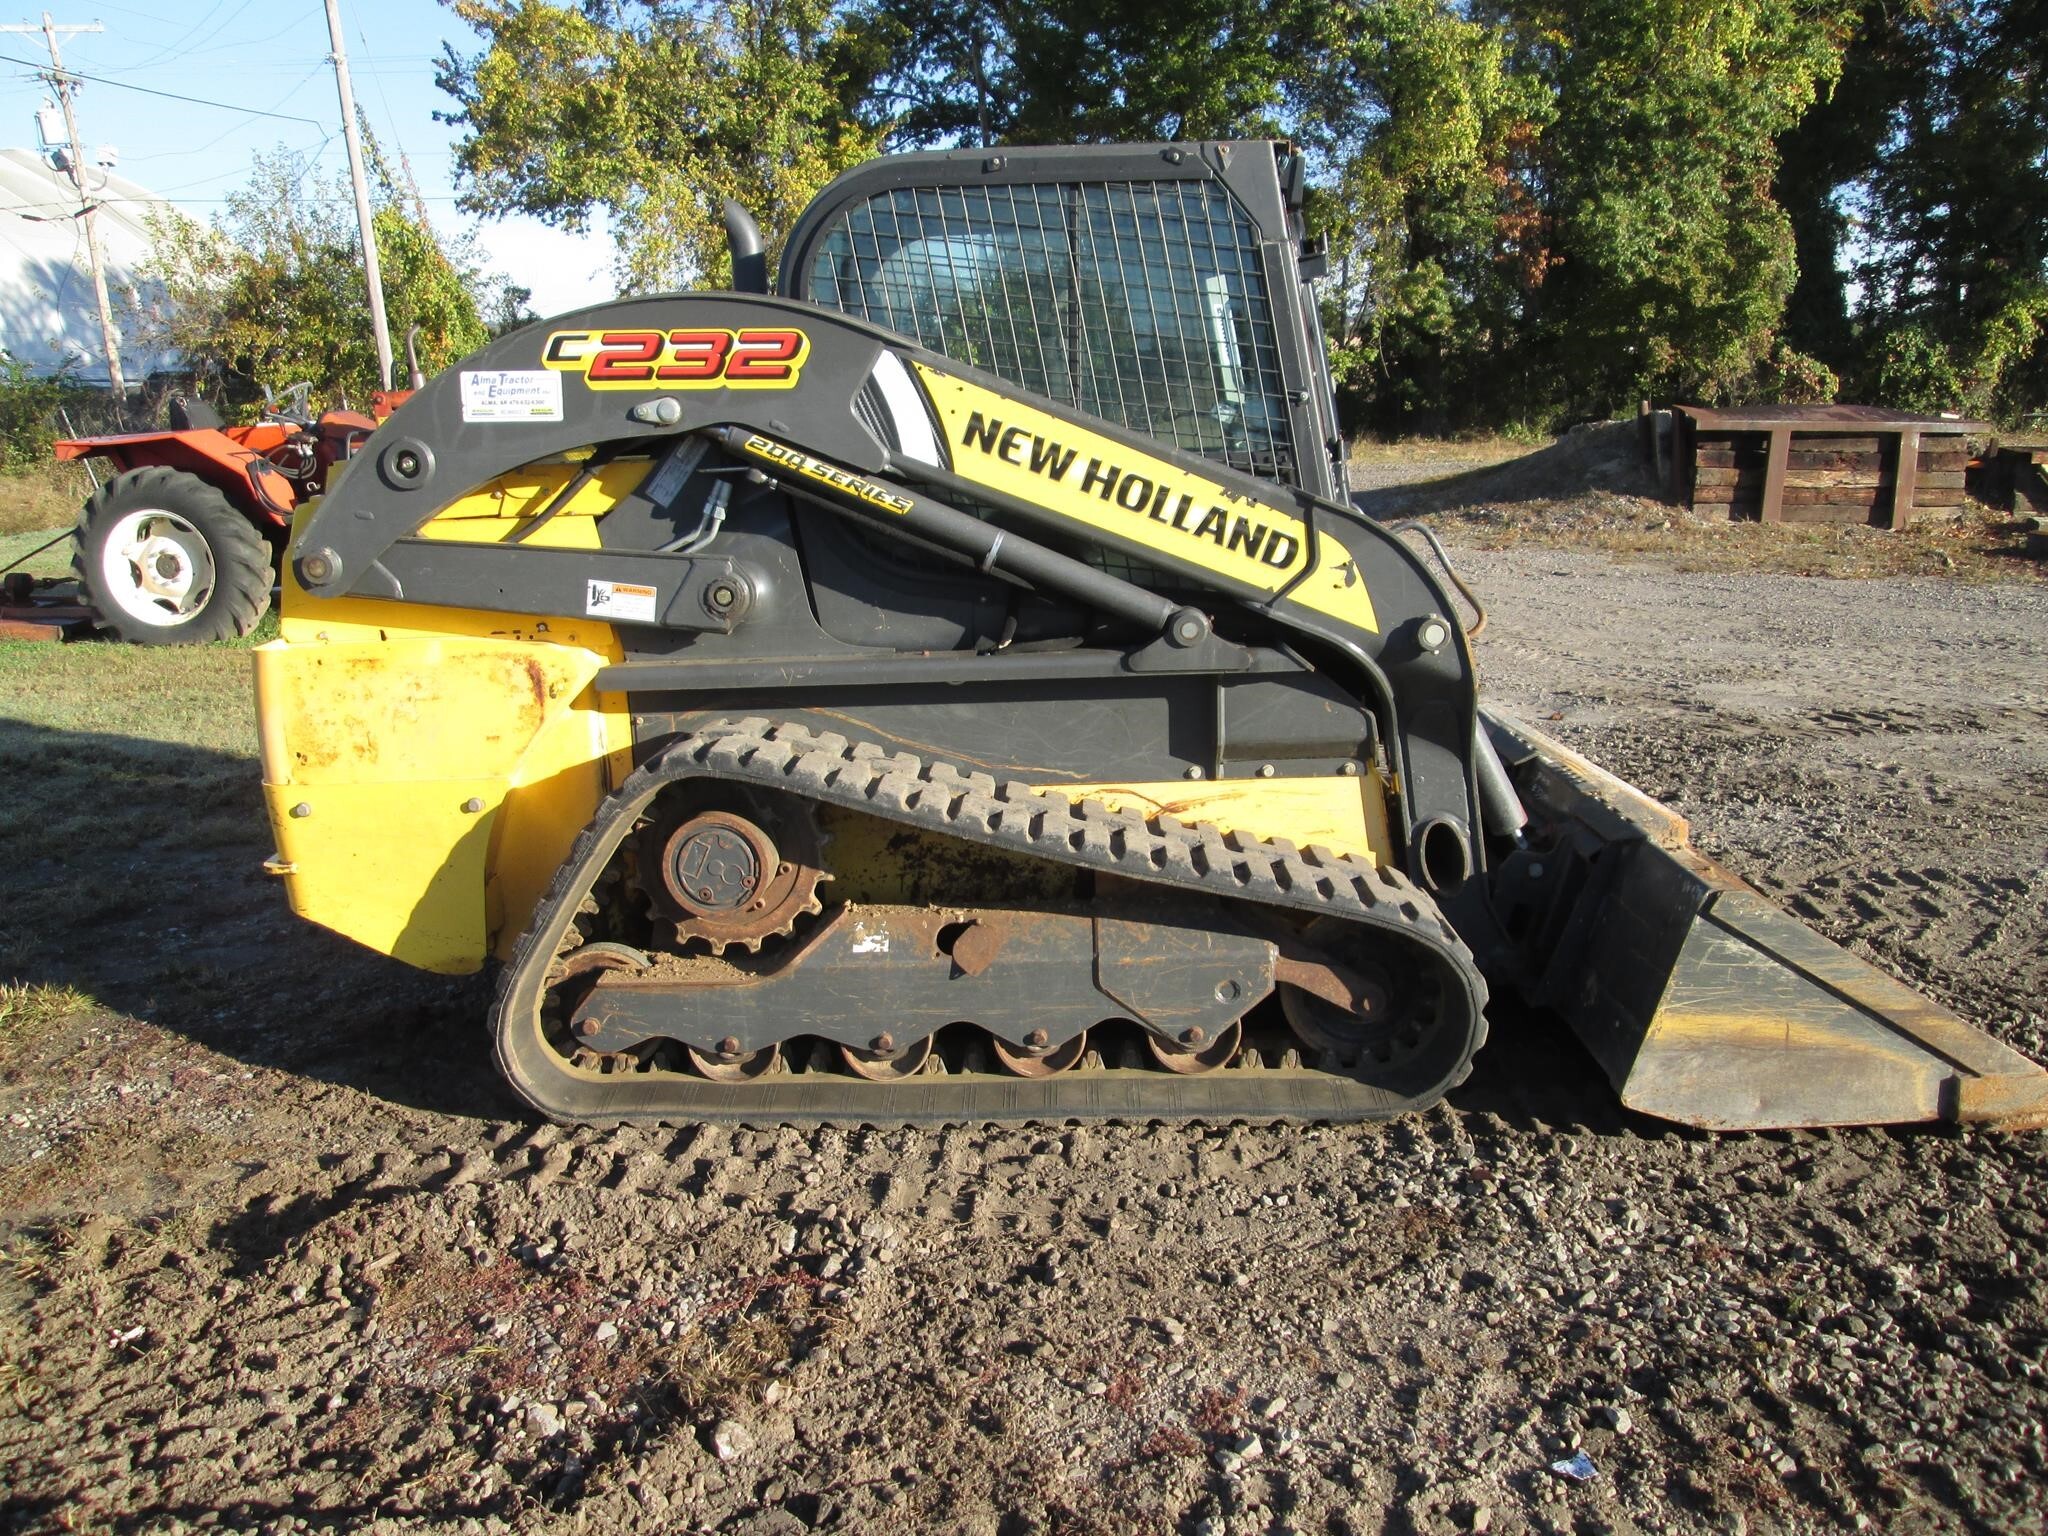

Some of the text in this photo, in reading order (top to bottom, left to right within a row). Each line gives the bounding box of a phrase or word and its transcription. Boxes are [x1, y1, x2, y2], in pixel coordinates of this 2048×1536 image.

[472, 373, 534, 386] Alma Tractor
[547, 331, 803, 381] C232
[488, 385, 540, 398] Equipment
[748, 437, 912, 510] 200 SERIES
[962, 410, 1300, 570] NEW HOLLAND
